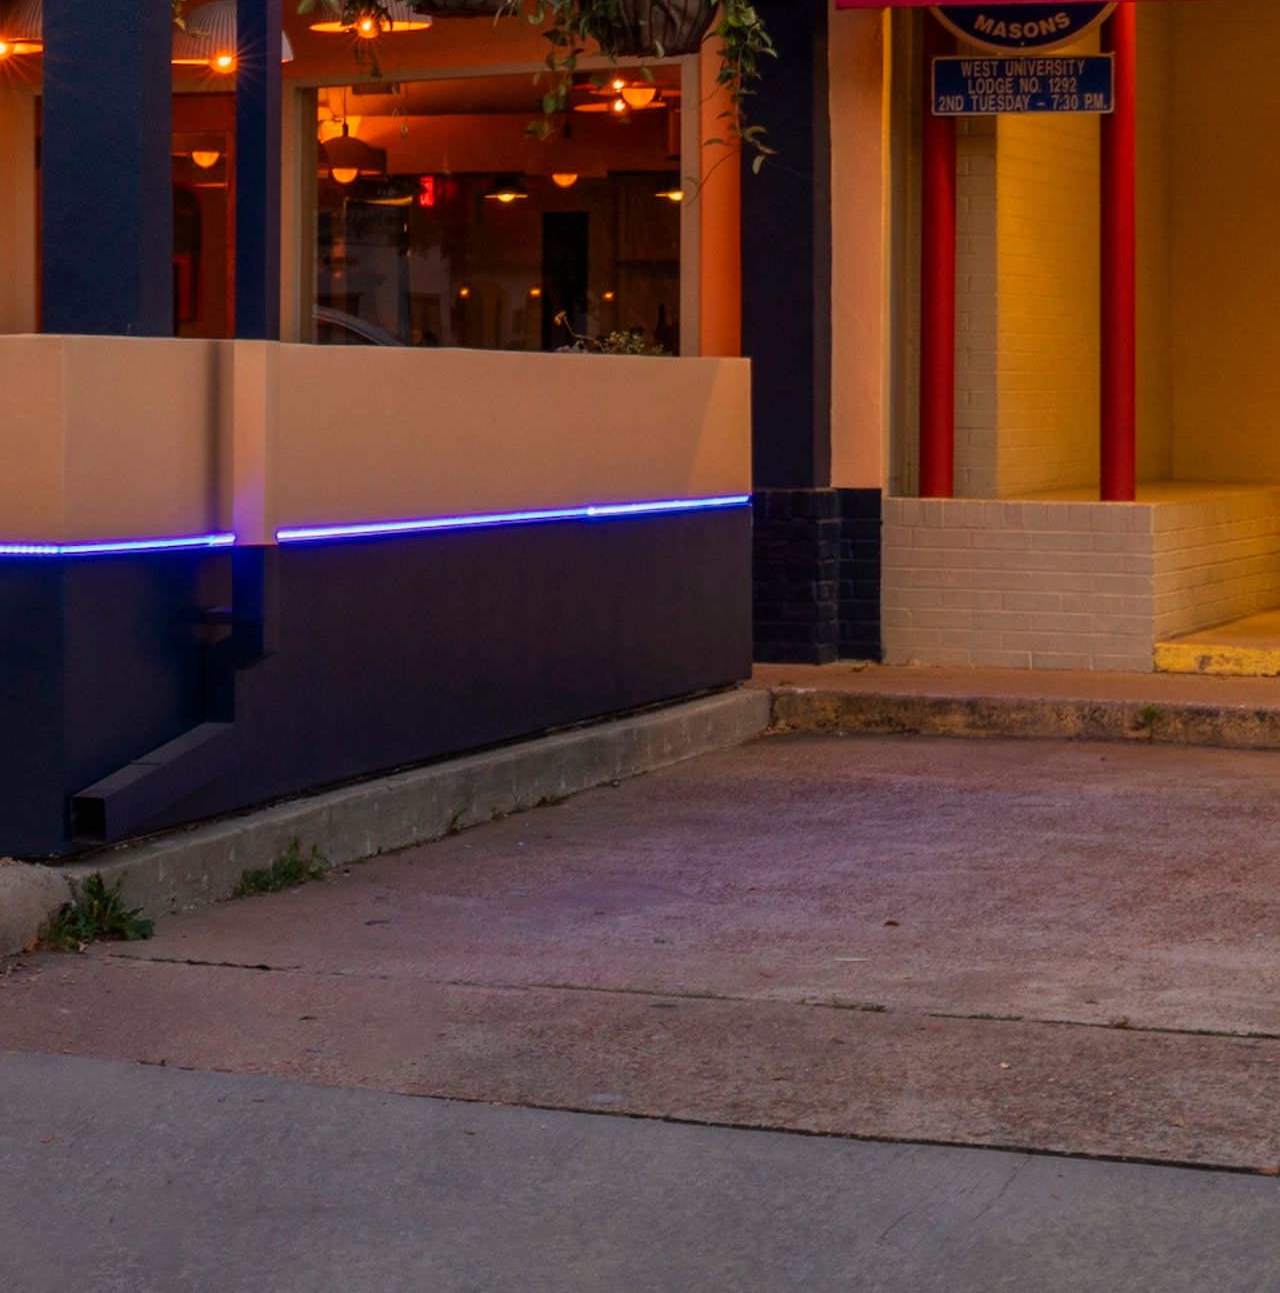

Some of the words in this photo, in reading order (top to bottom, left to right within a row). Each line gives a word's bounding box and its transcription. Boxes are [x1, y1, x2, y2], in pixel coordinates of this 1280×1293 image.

[973, 12, 1071, 39] MASONS
[960, 60, 999, 77] WEST
[1005, 59, 1086, 76] UNIVERSITY
[967, 78, 1014, 95] LODGE
[1019, 77, 1042, 94] NO.
[1048, 77, 1078, 93] 1292
[938, 95, 964, 112] 2ND
[971, 94, 1030, 112] TUESDAY
[1050, 94, 1079, 111] 7:30
